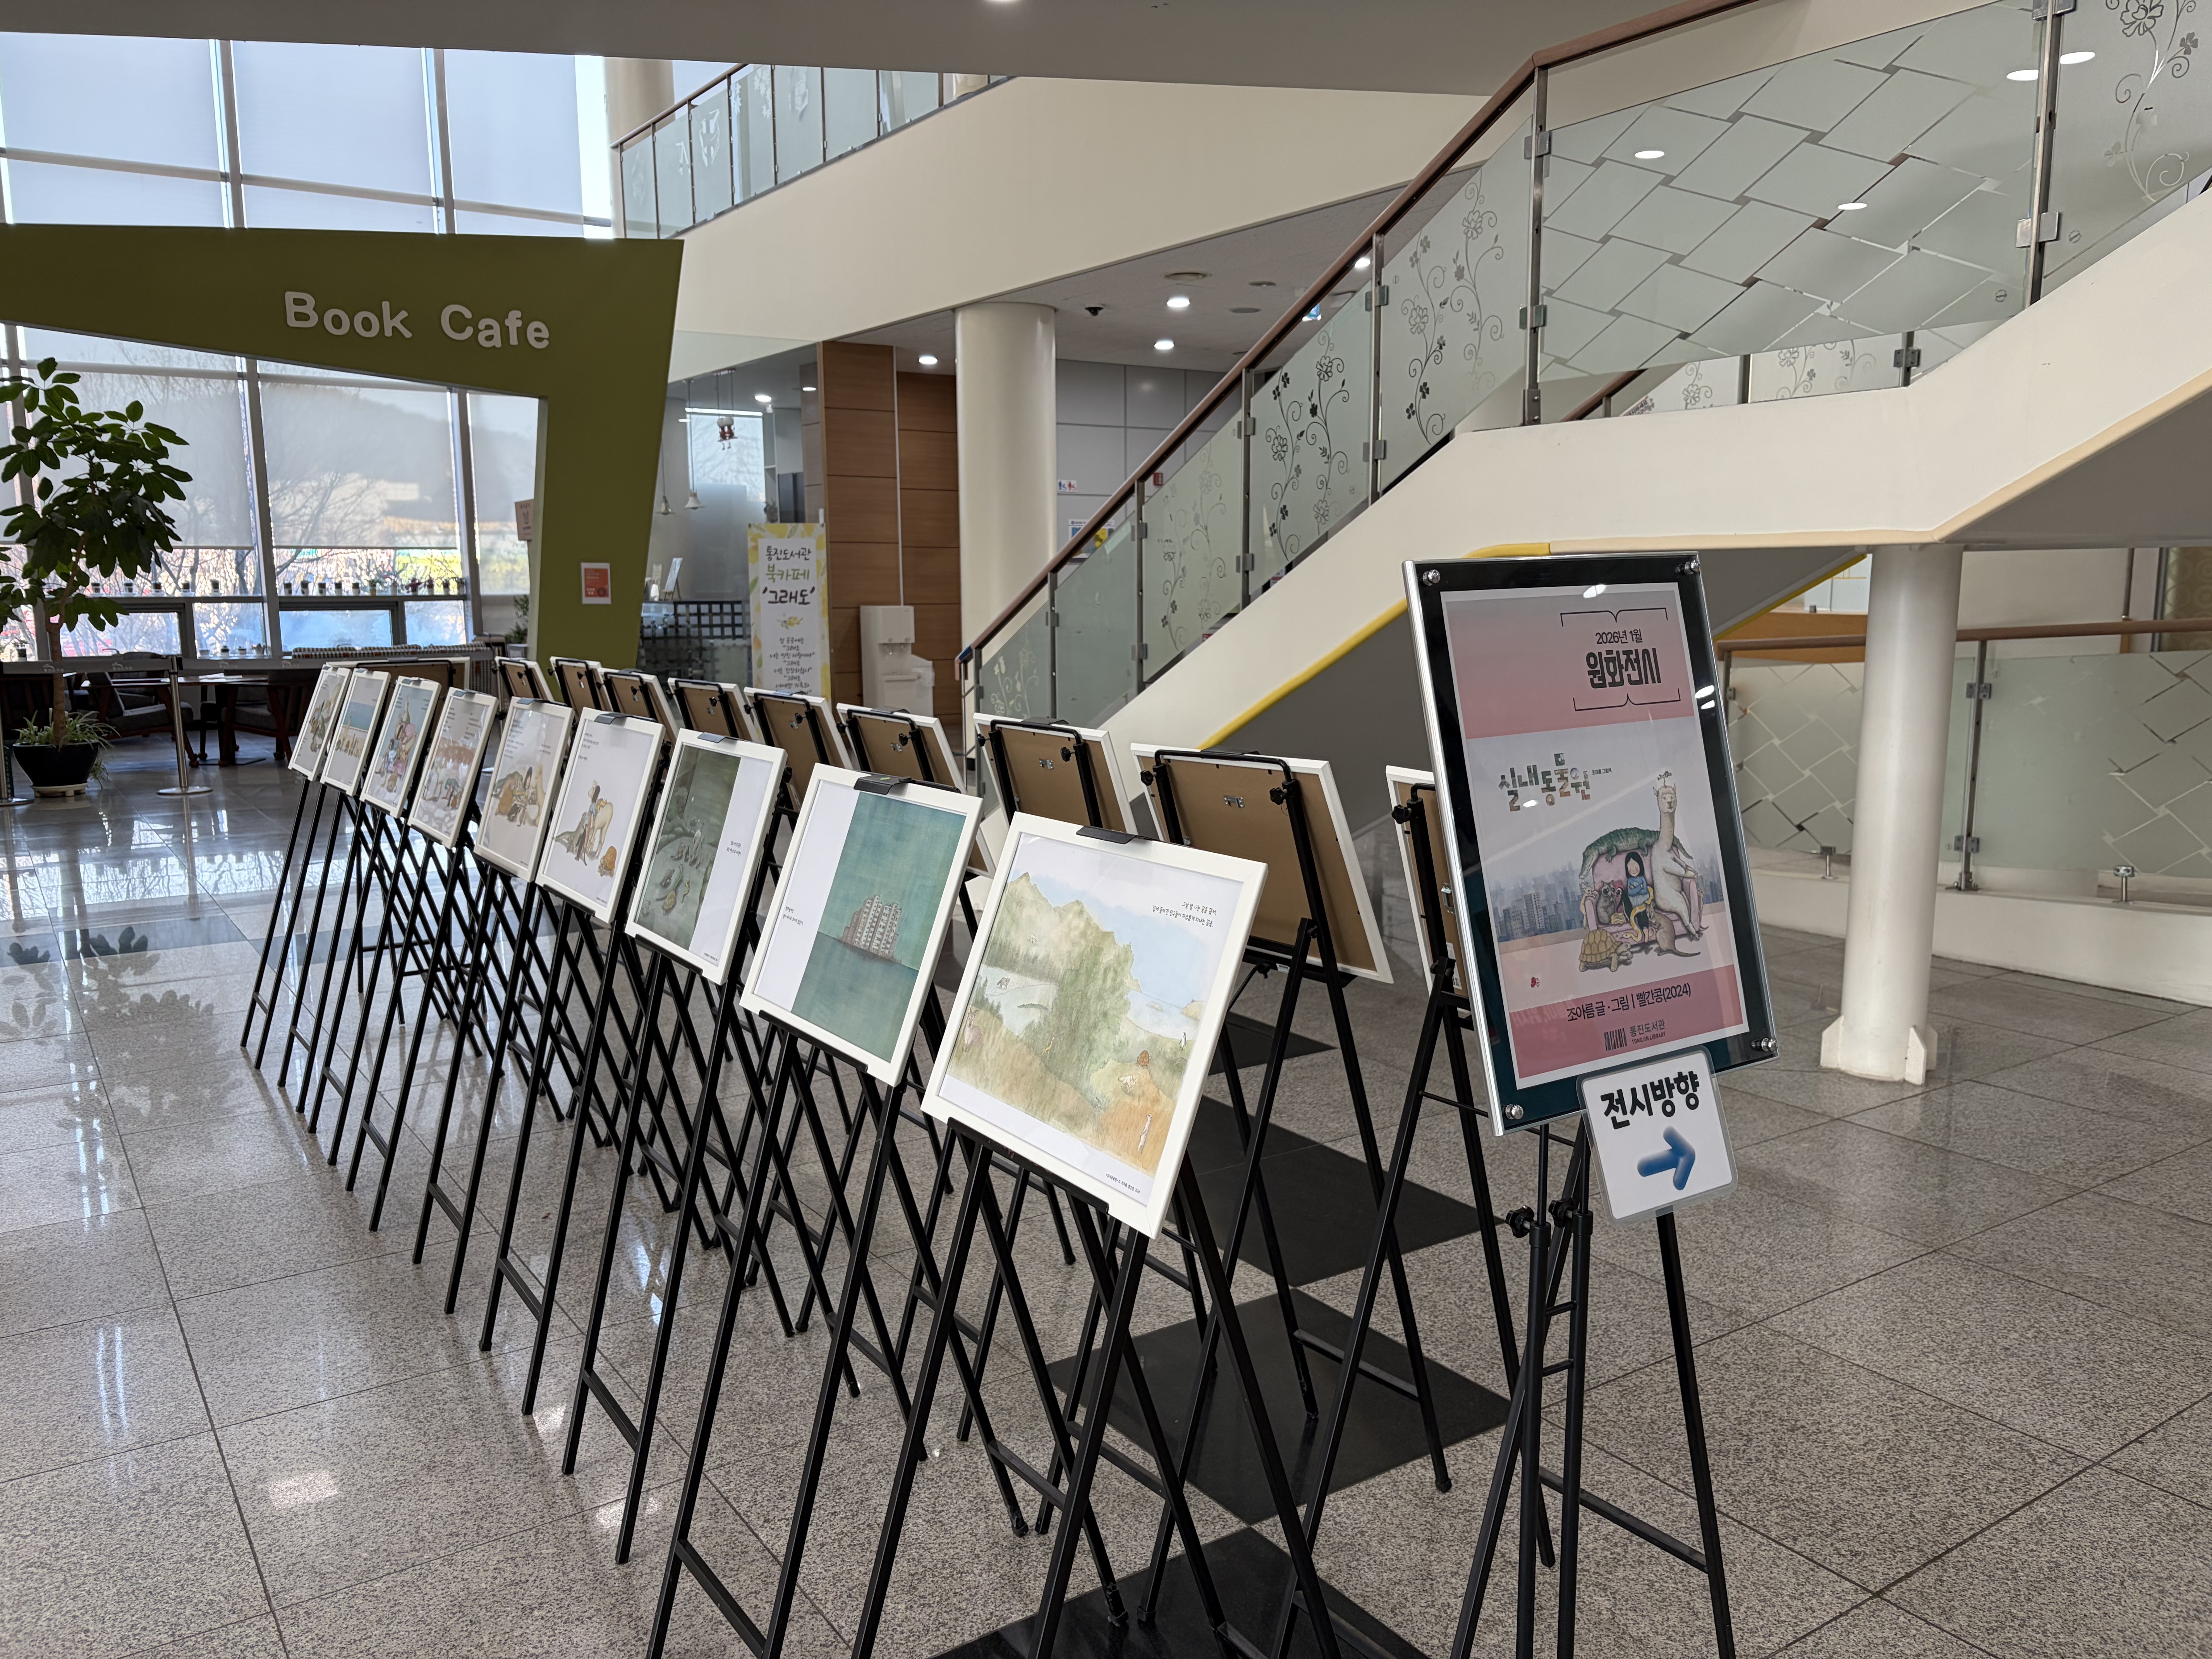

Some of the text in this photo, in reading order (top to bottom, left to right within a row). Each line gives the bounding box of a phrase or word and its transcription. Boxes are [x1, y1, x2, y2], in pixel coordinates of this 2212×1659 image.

[285, 291, 549, 349] Book Cafe
[766, 546, 811, 561] 통진도서관
[766, 564, 810, 583] 북카페
[1595, 629, 1643, 644] 2026년 1월
[1586, 648, 1661, 689] 원화전시
[1498, 753, 1590, 812] 실내동물원
[1170, 909, 1182, 918] 친구들이
[1566, 1003, 1595, 1021] 조아름
[1636, 982, 1691, 1008] 빨간콩(2024)
[1630, 1019, 1665, 1037] 통진도서관
[1632, 1031, 1666, 1044] TONGJIN LIBRARY
[1601, 1071, 1700, 1130] 전시방향
